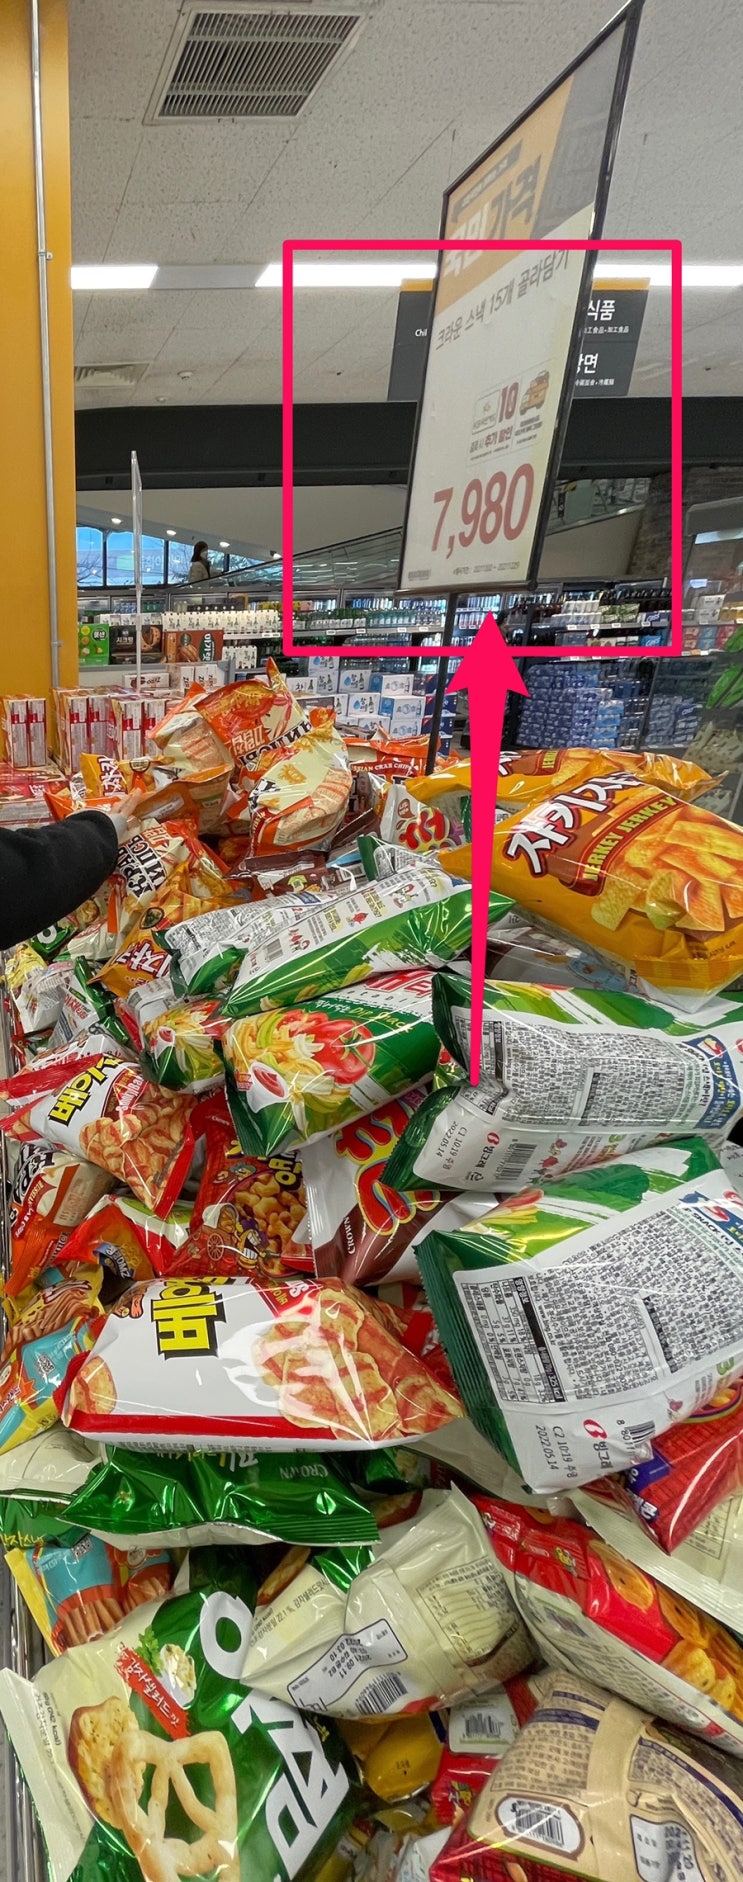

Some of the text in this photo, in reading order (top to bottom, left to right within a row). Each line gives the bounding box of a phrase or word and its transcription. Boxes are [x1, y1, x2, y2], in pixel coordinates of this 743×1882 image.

[435, 249, 570, 350] 크라운 스낵 15개 골라담기
[499, 382, 519, 422] 10
[431, 463, 534, 559] 7,980
[476, 1146, 495, 1169] 빙그레
[343, 1216, 356, 1256] CROWN
[593, 1440, 613, 1471] 빙그레
